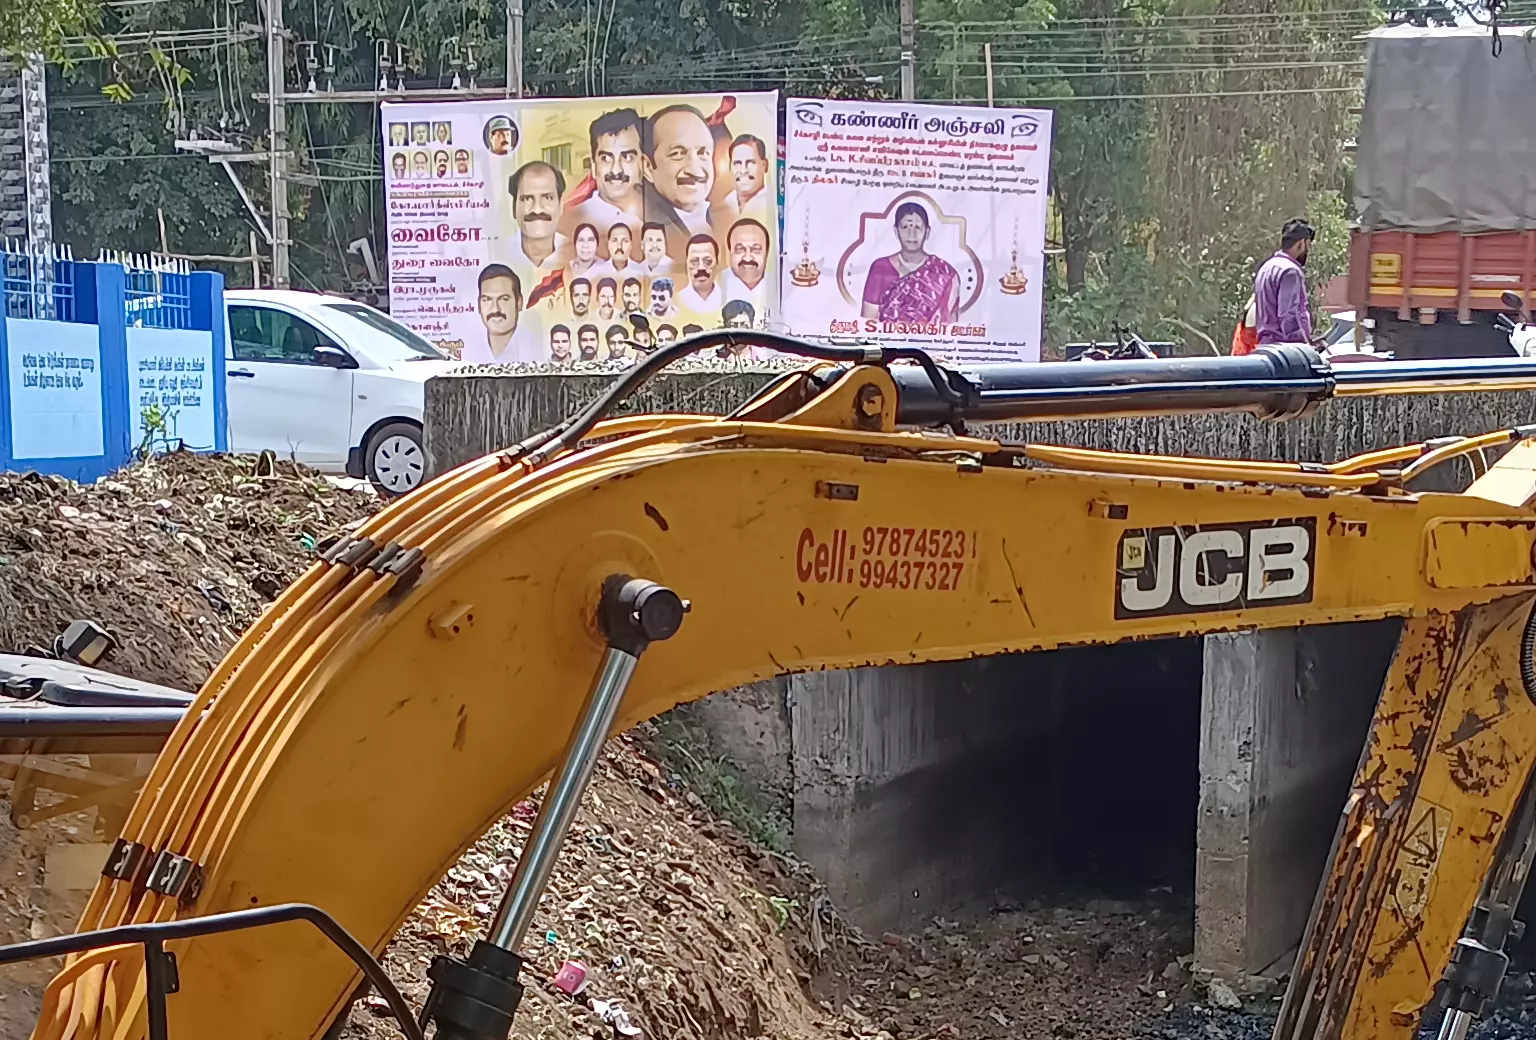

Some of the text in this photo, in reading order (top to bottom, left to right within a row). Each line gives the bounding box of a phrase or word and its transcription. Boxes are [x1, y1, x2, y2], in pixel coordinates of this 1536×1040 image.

[830, 110, 1005, 138] கண்ணீர் அஞ்சலி
[390, 223, 482, 243] வைகோ
[392, 256, 480, 270] துரை வைகோ
[796, 527, 856, 584] Cell:
[1121, 525, 1310, 611] JCB
